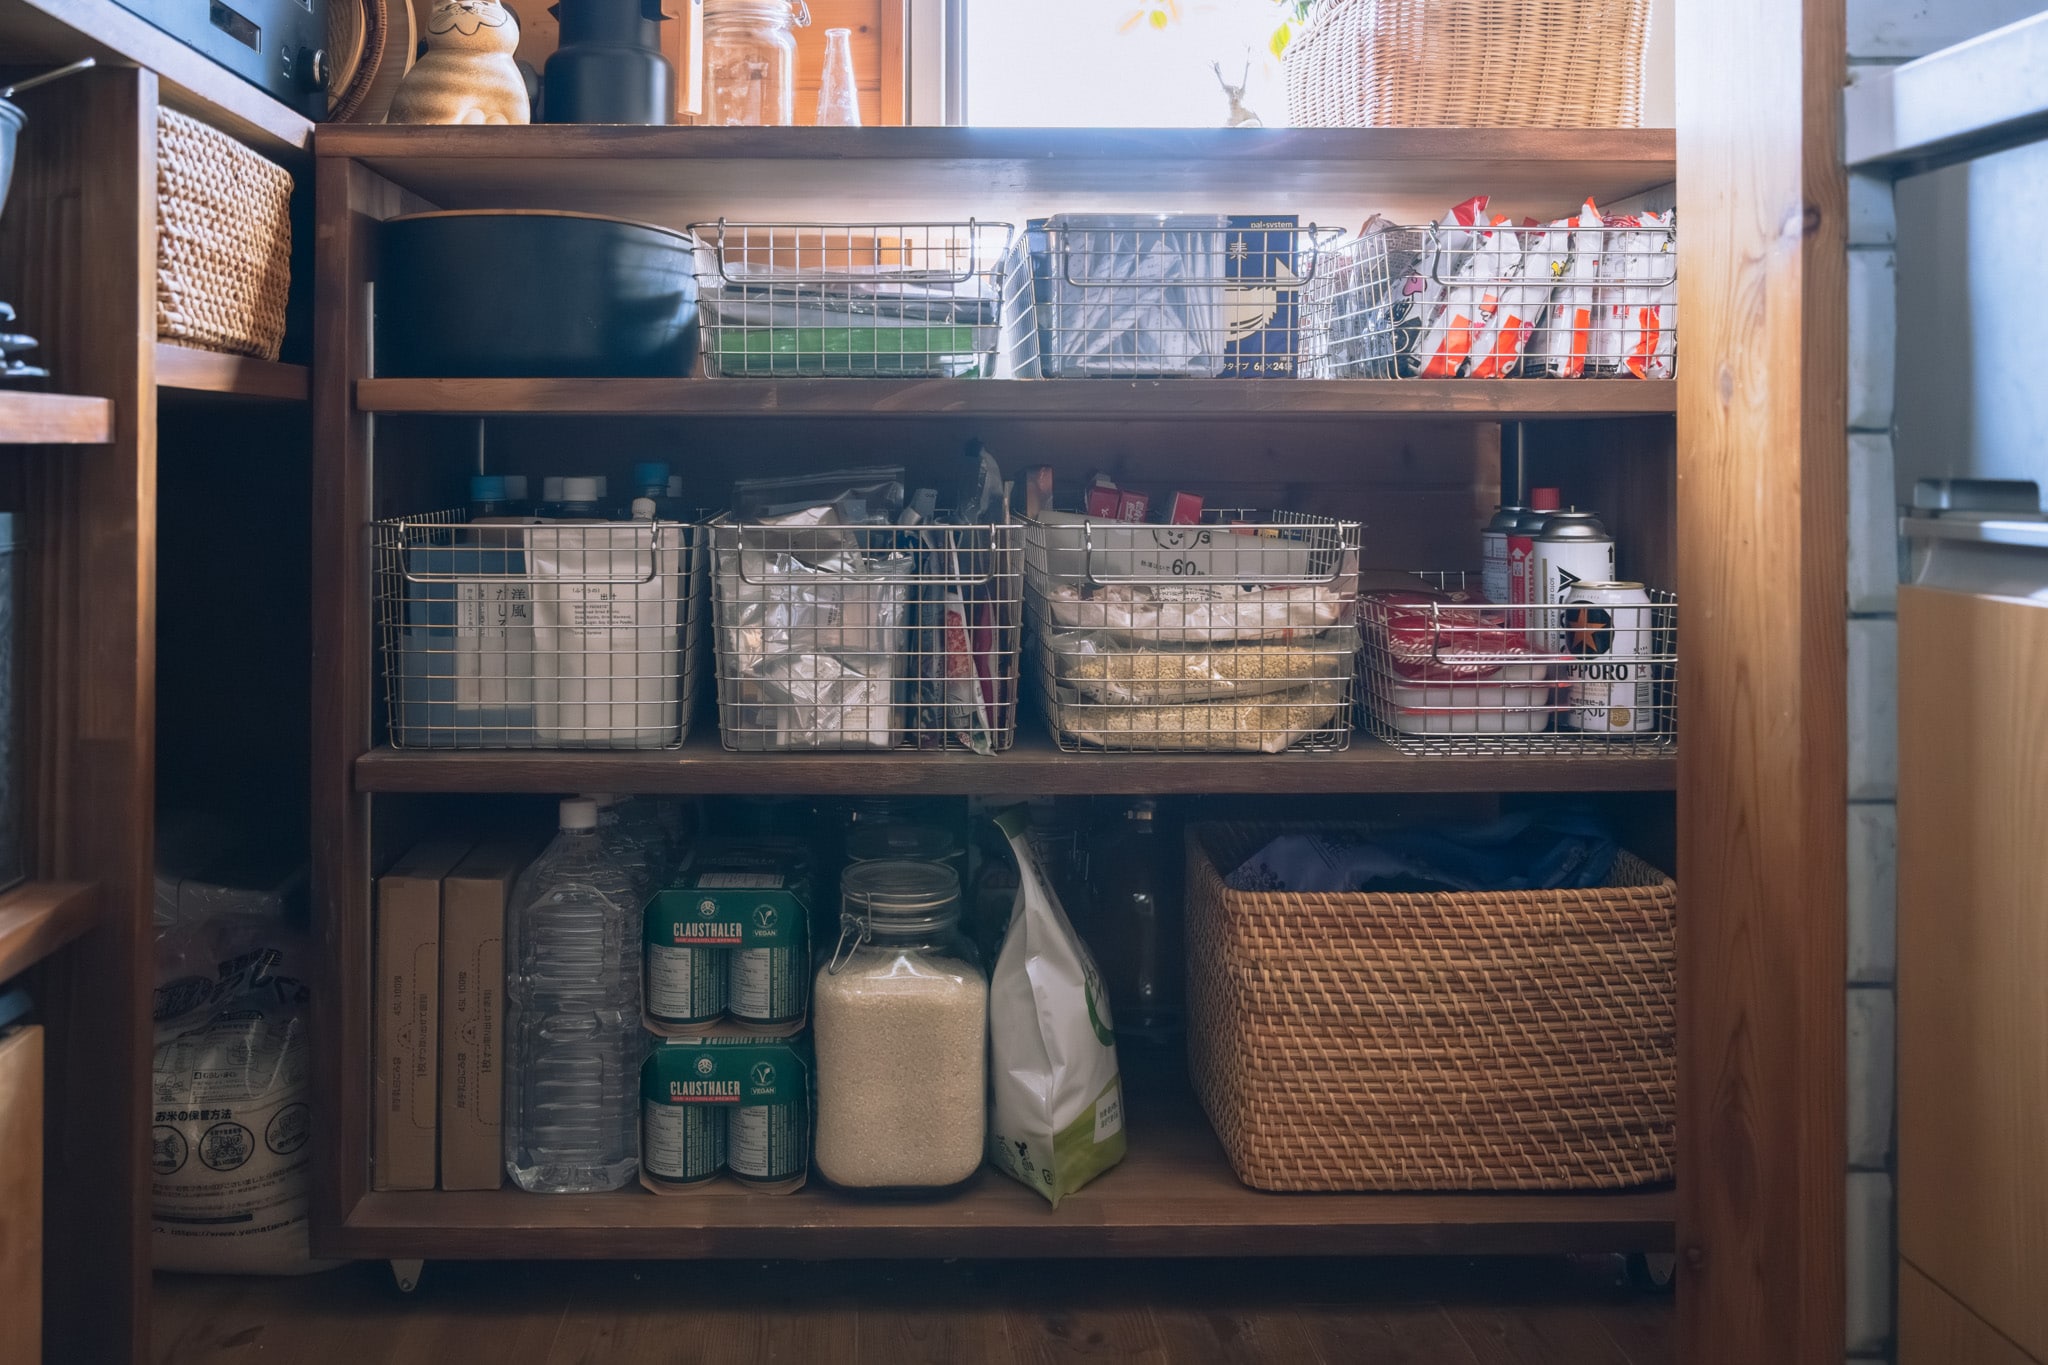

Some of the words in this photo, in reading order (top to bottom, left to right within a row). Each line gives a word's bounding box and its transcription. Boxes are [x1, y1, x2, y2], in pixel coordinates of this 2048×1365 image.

[511, 588, 527, 618] 洋風
[1567, 664, 1628, 680] PPORO
[673, 922, 743, 938] CLAUSTHALER
[670, 1080, 741, 1096] CLAUSTHALER
[155, 1108, 232, 1122] お米の保管方法
